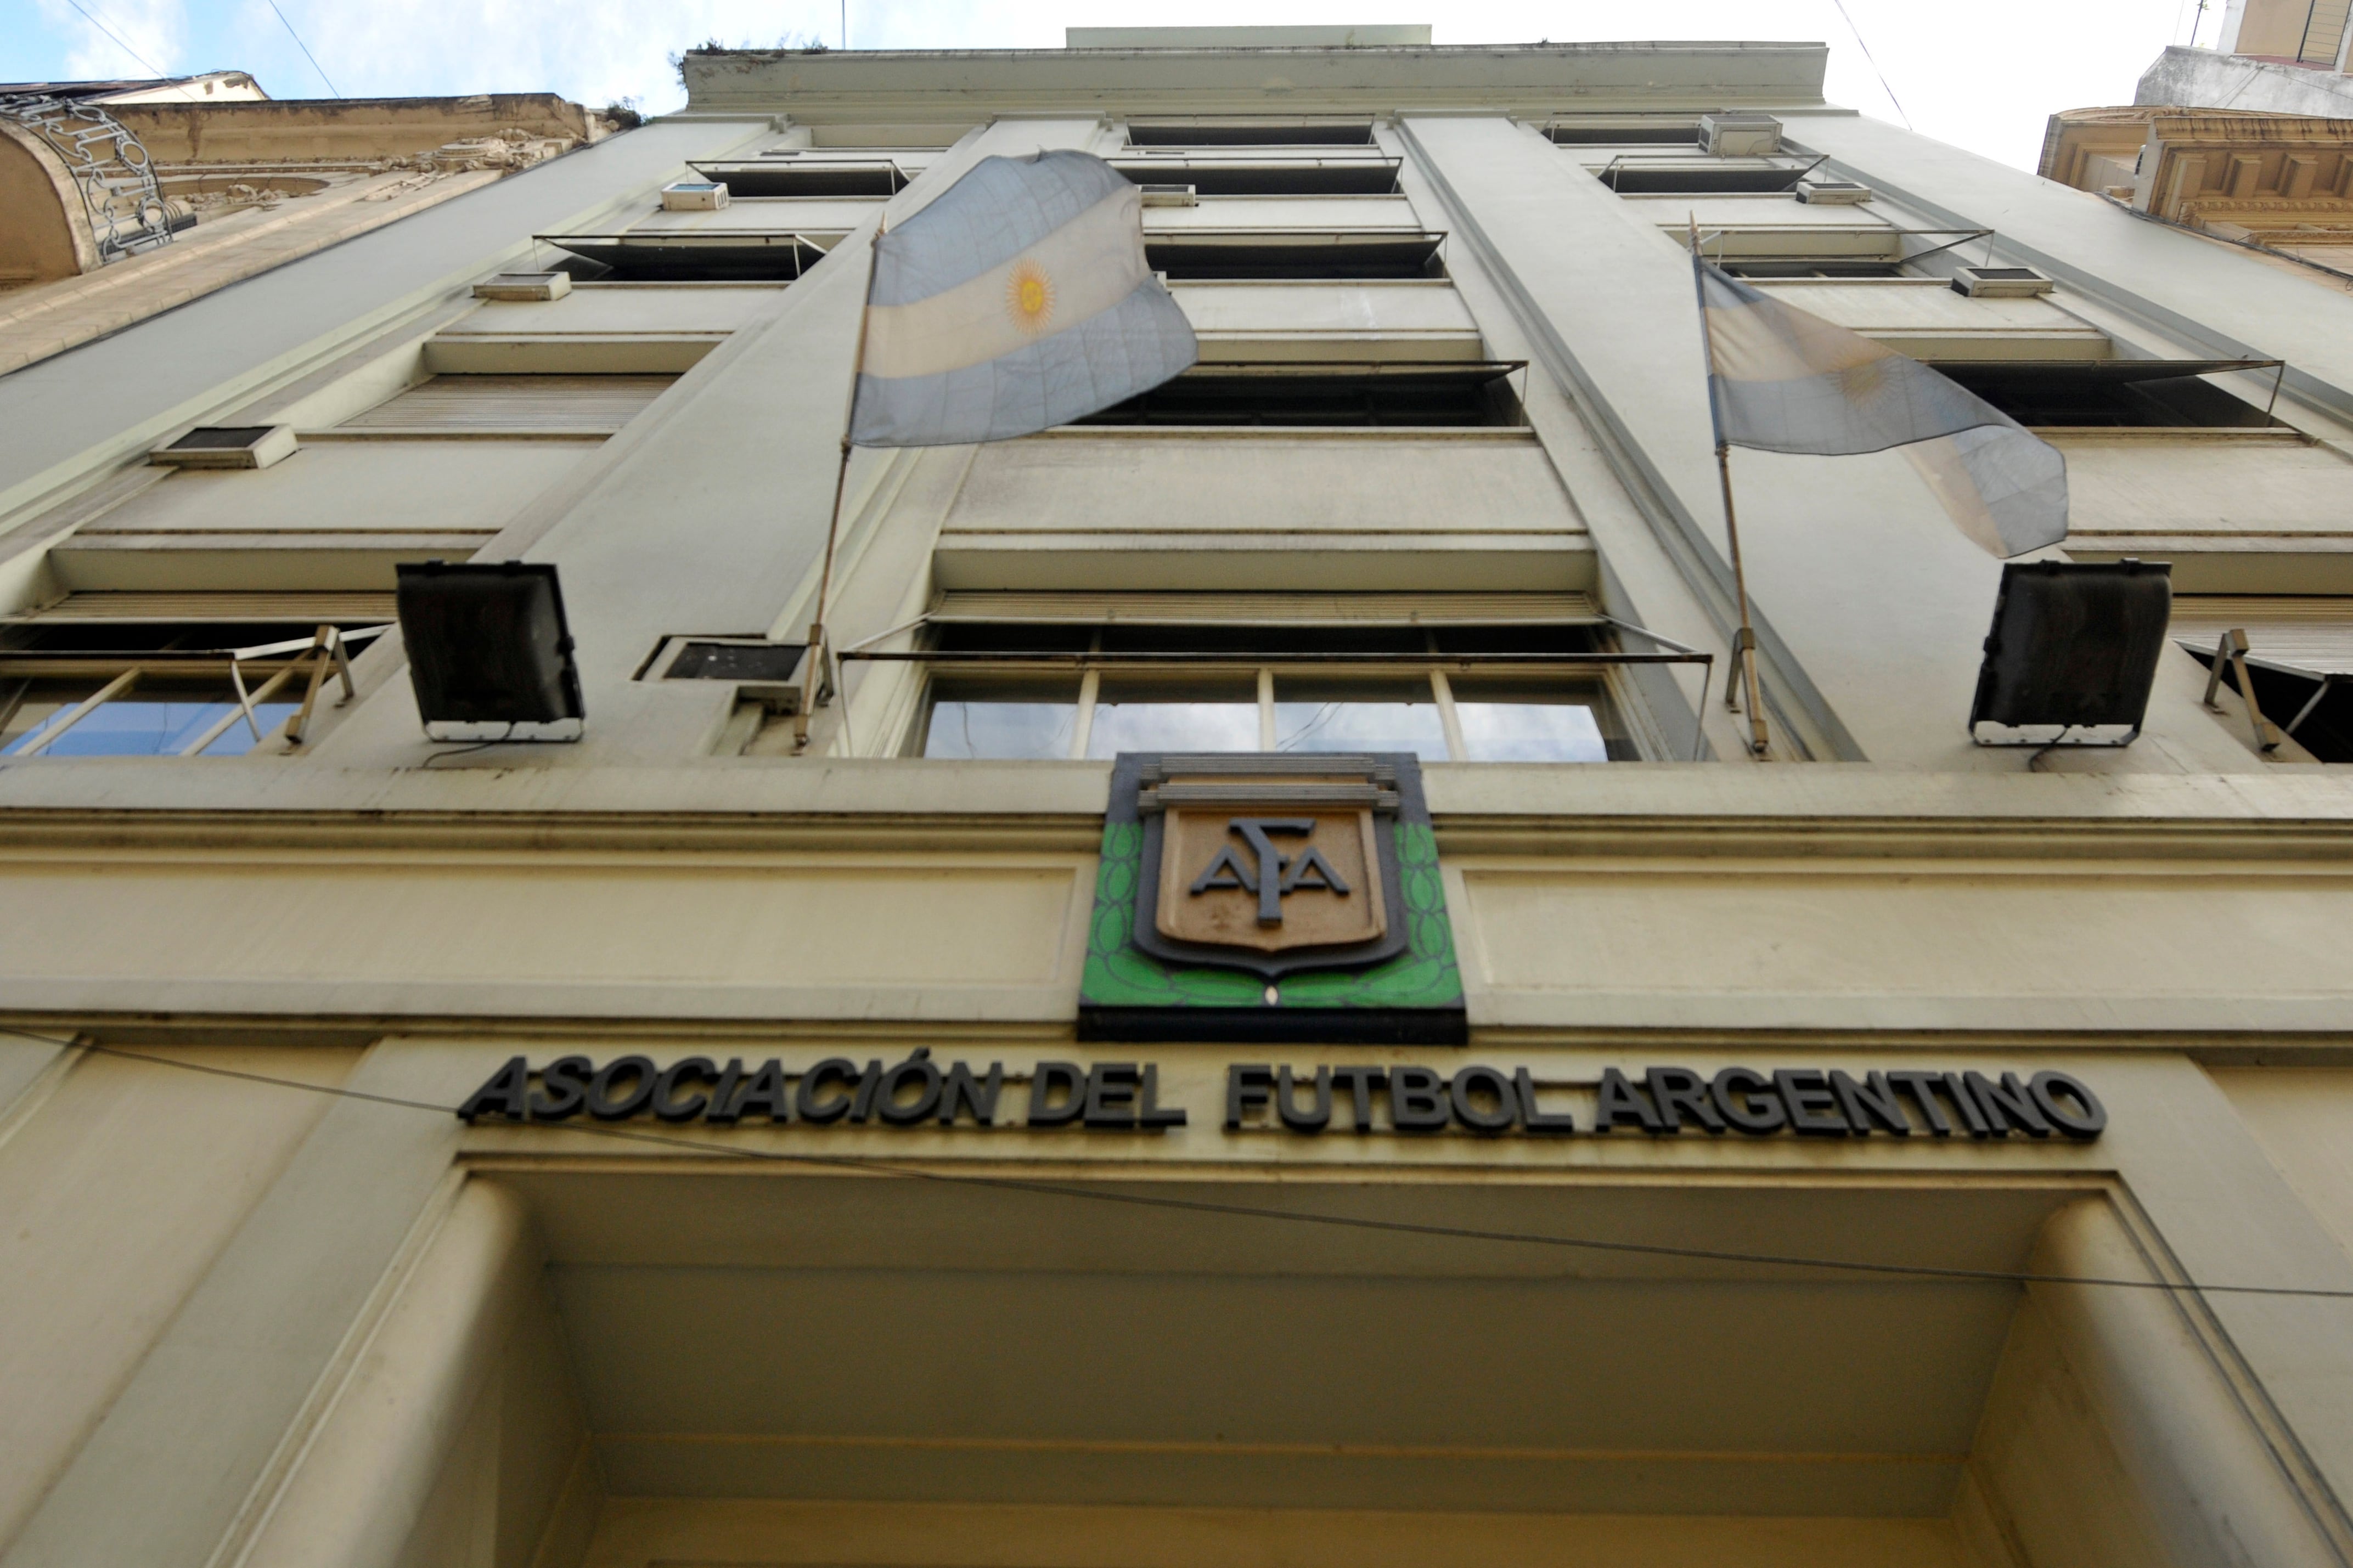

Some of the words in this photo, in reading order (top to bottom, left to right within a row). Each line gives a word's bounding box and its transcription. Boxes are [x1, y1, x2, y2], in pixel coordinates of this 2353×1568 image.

[457, 1047, 1003, 1127] ASOCIACIÓN
[1028, 1062, 1187, 1129] DEL
[1225, 1063, 1573, 1131] FUTBOL
[1595, 1067, 2106, 1139] ARGENTINO
